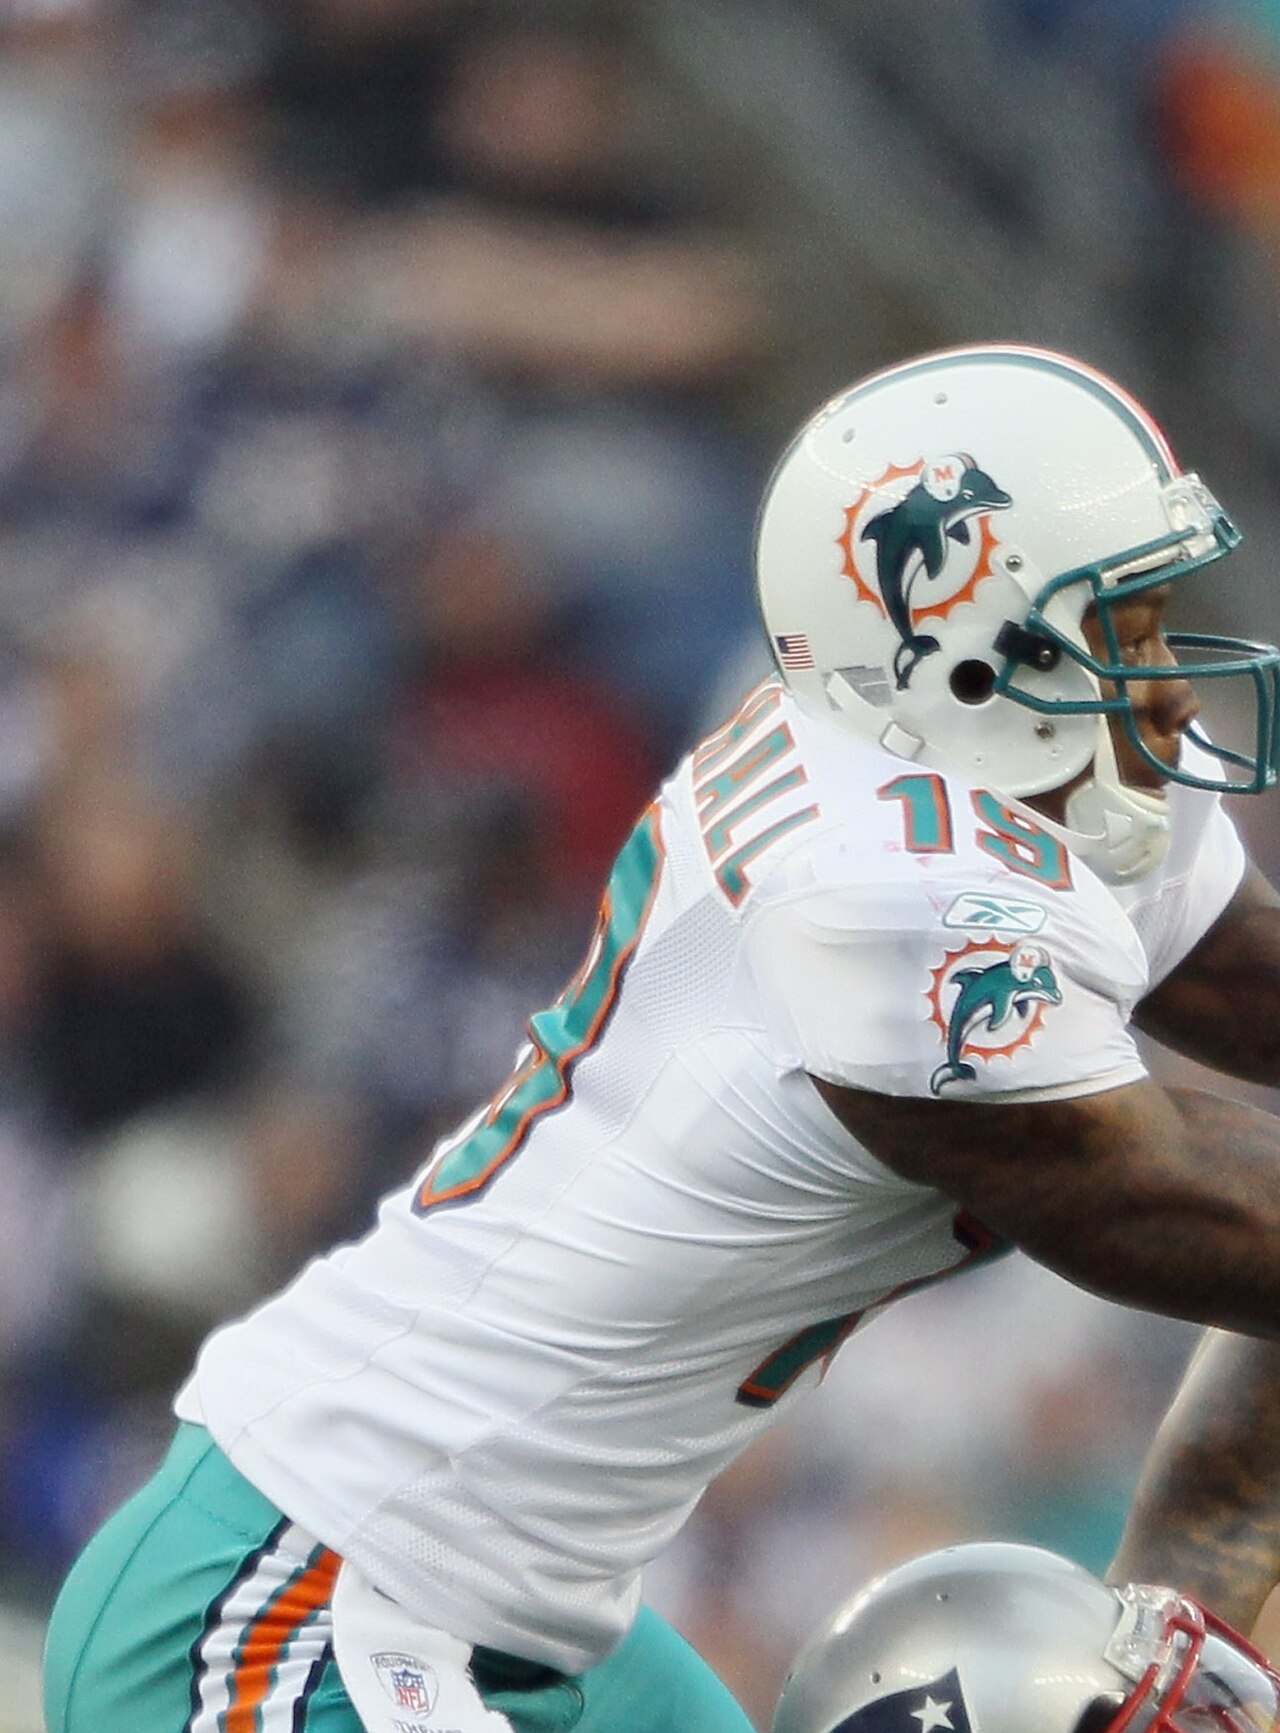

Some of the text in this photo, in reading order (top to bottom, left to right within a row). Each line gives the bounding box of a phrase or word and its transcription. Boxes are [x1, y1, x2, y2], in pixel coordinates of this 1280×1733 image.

[933, 464, 954, 482] M
[692, 676, 821, 908] HALL
[877, 773, 1075, 892] 19
[397, 1685, 428, 1711] NFL
